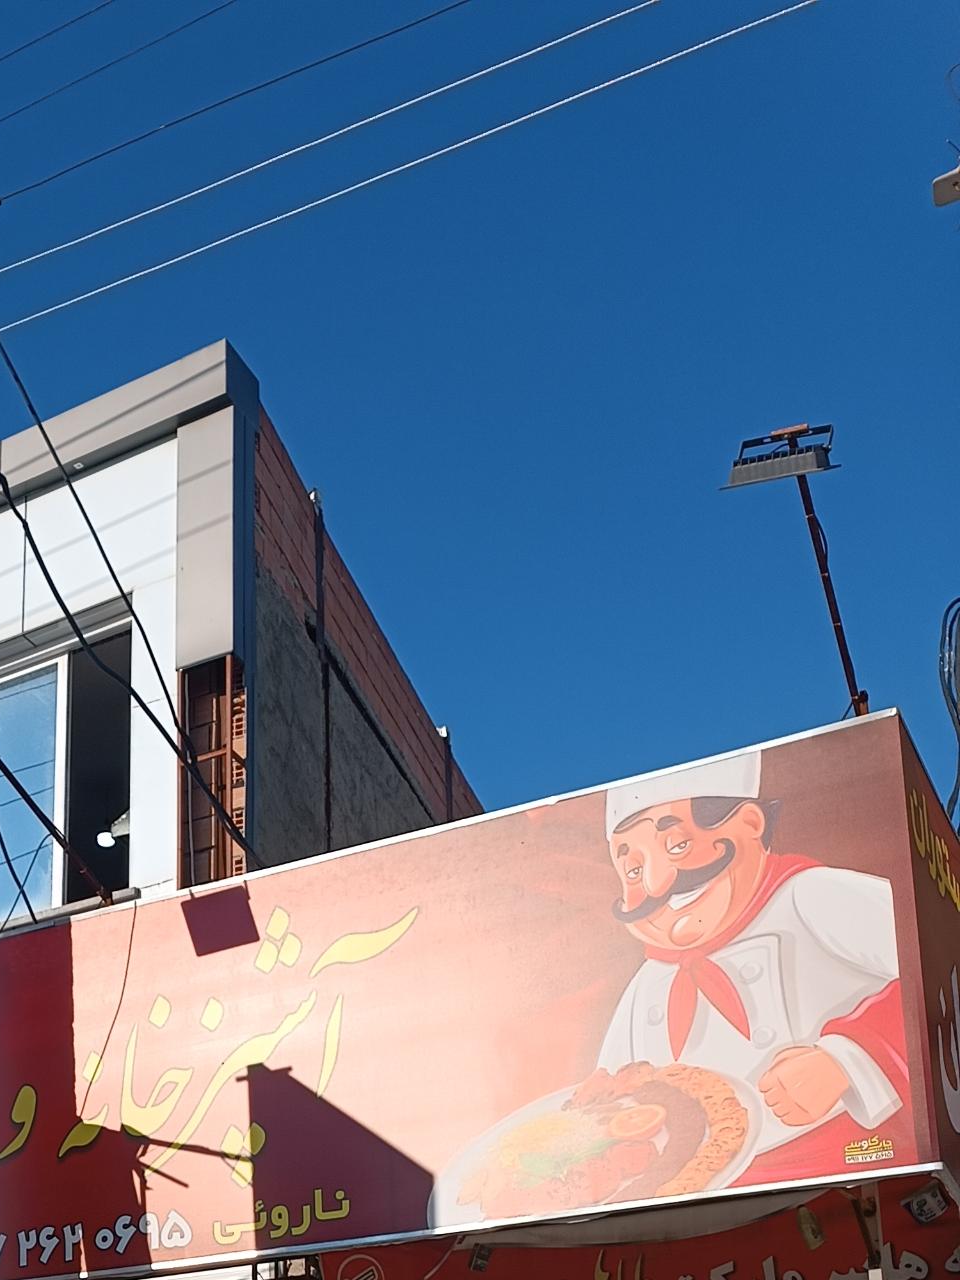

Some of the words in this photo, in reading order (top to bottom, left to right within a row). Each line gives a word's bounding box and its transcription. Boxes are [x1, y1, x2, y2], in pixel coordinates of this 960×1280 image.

[58, 905, 420, 1188] آشپزخانه
[17, 1223, 83, 1268] ۲۶۲
[95, 1208, 193, 1254] ۰۶۹۵
